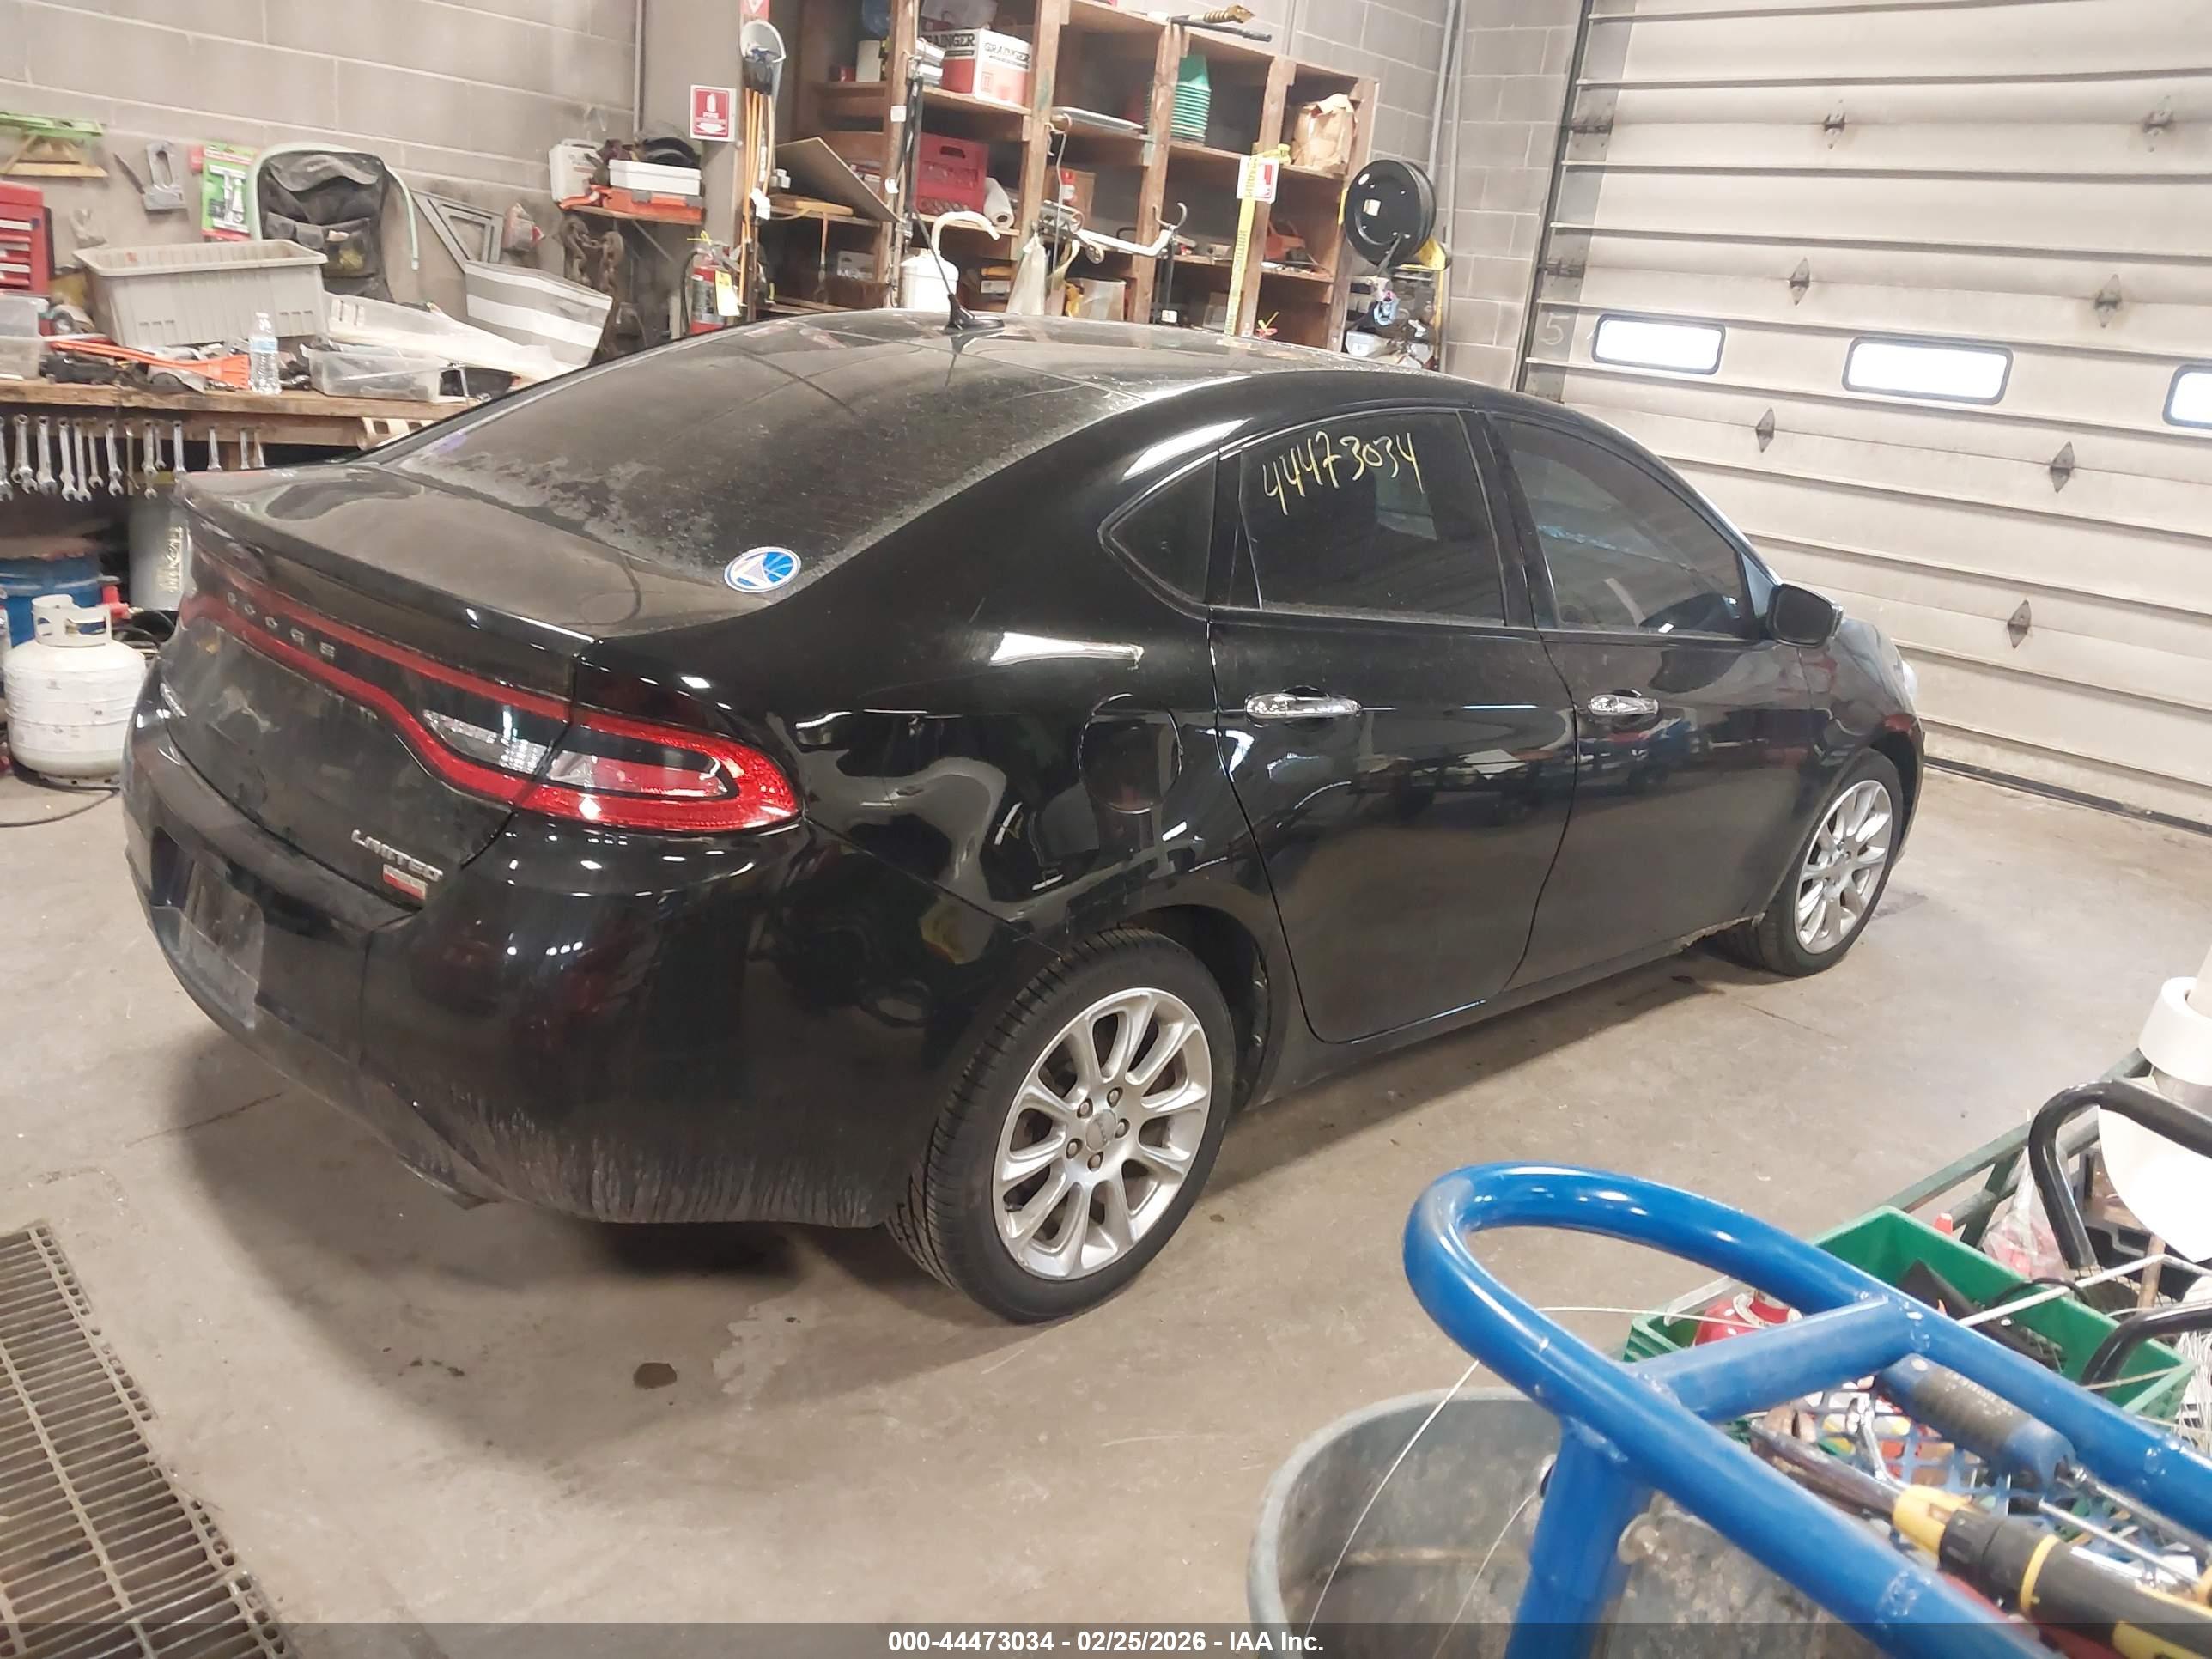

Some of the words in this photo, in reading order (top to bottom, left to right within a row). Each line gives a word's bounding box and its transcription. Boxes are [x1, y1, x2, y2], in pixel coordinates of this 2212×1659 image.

[1540, 313, 1570, 345] 5
[1262, 430, 1425, 515] 44473034
[227, 592, 336, 660] DODGE
[350, 829, 443, 882] LIMITED
